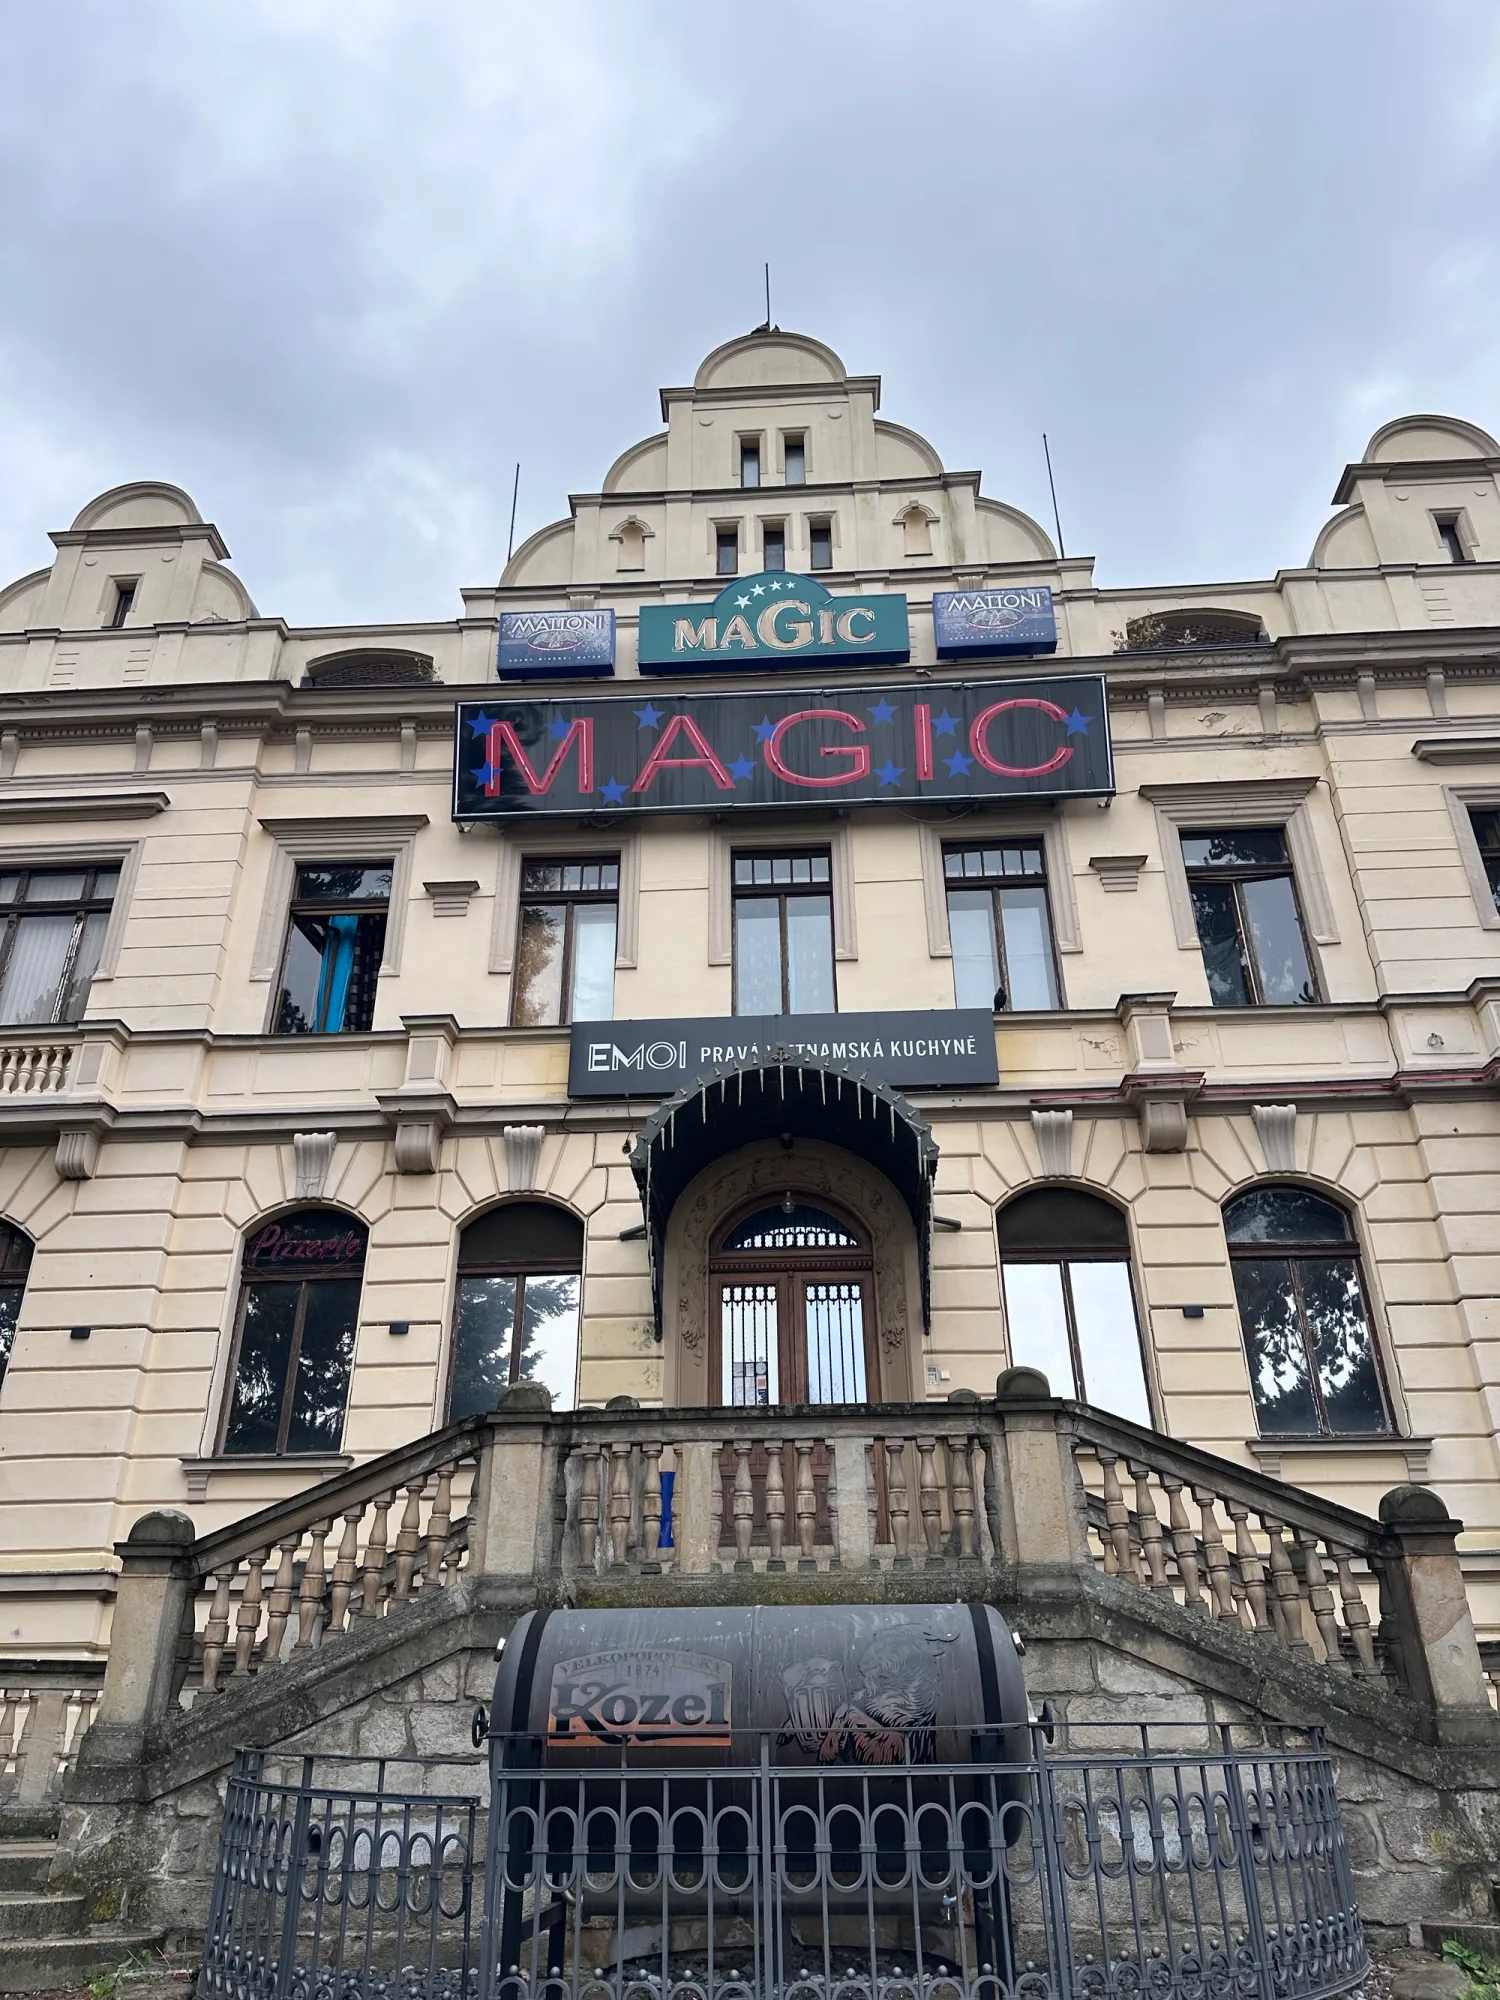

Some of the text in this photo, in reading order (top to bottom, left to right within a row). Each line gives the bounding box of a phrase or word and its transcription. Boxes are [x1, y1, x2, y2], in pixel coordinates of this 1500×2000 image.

[947, 593, 1041, 612] MATTONI
[511, 615, 604, 633] MATTONI
[672, 600, 876, 652] MAGIC
[484, 698, 1075, 797] MAGIC
[588, 1040, 687, 1072] EMOI
[766, 1038, 885, 1060] TNAMSKÁ
[890, 1034, 977, 1058] KUCHYNĚ
[627, 1664, 660, 1677] 1874
[549, 1682, 732, 1745] Kozel
